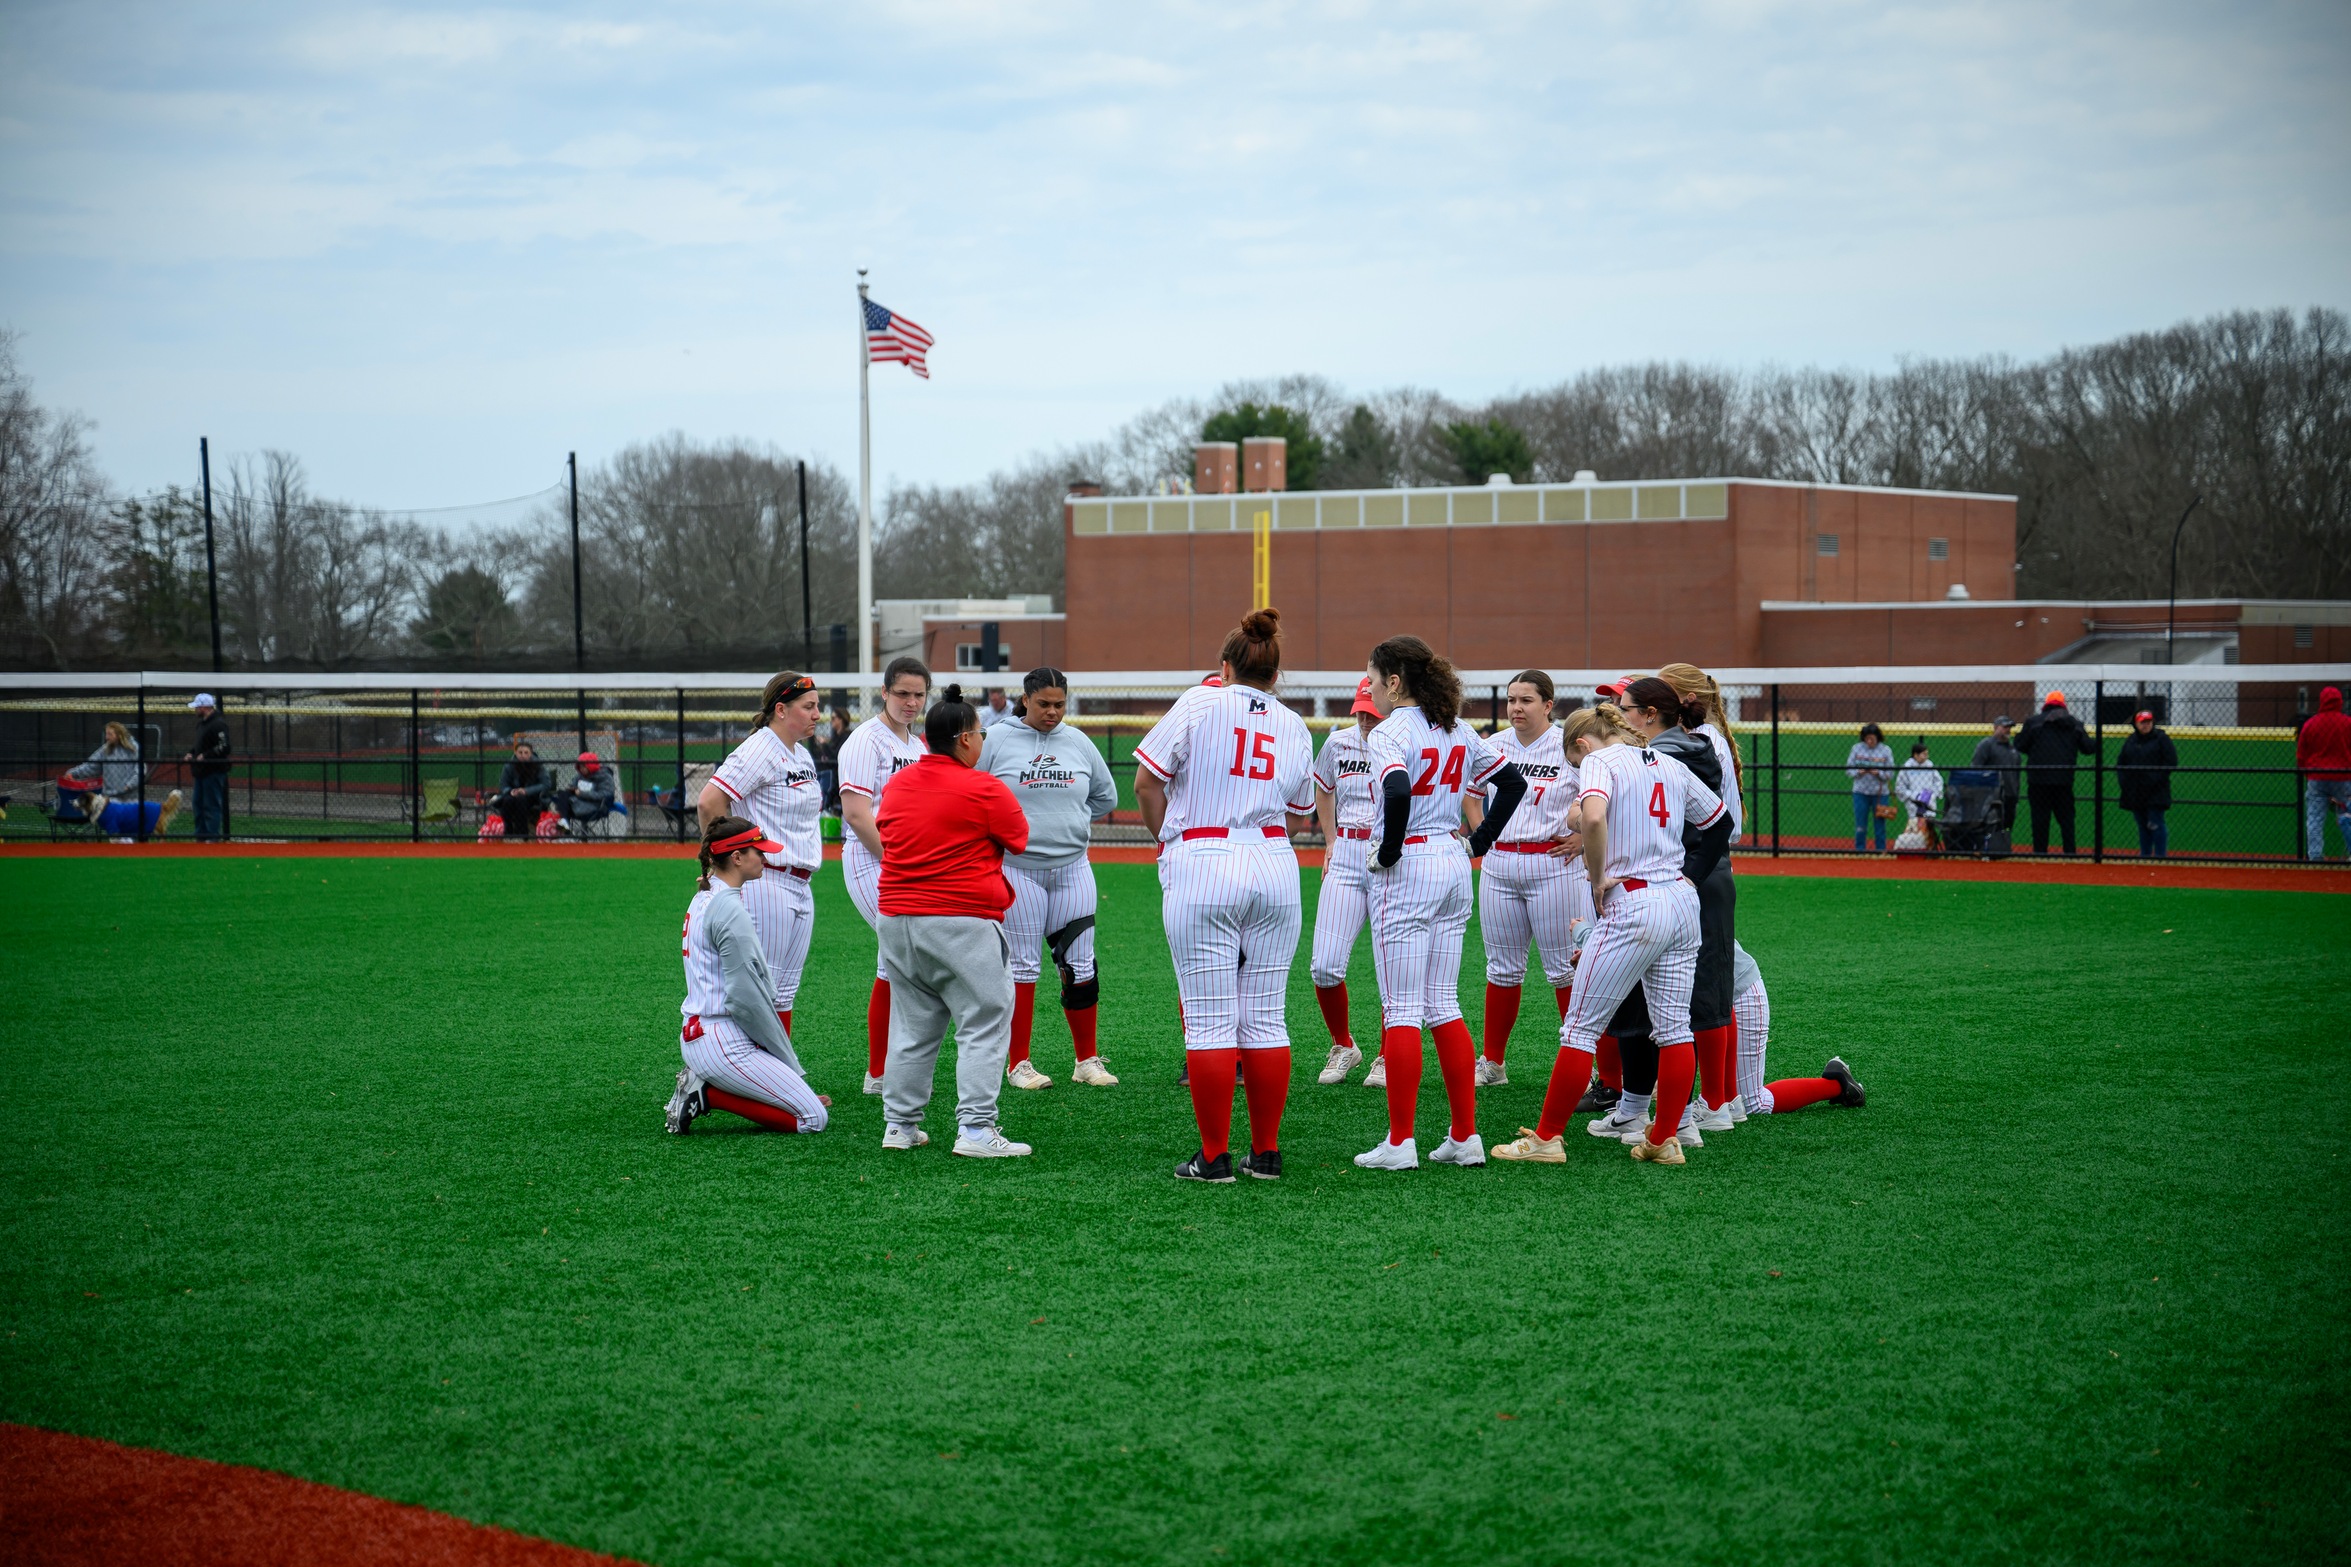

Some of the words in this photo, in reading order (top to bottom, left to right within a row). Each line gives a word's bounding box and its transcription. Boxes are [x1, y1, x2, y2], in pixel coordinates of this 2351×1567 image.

[1230, 727, 1275, 781] 15
[1411, 745, 1466, 796] 24
[1533, 786, 1545, 806] 7
[1649, 782, 1670, 828] 4
